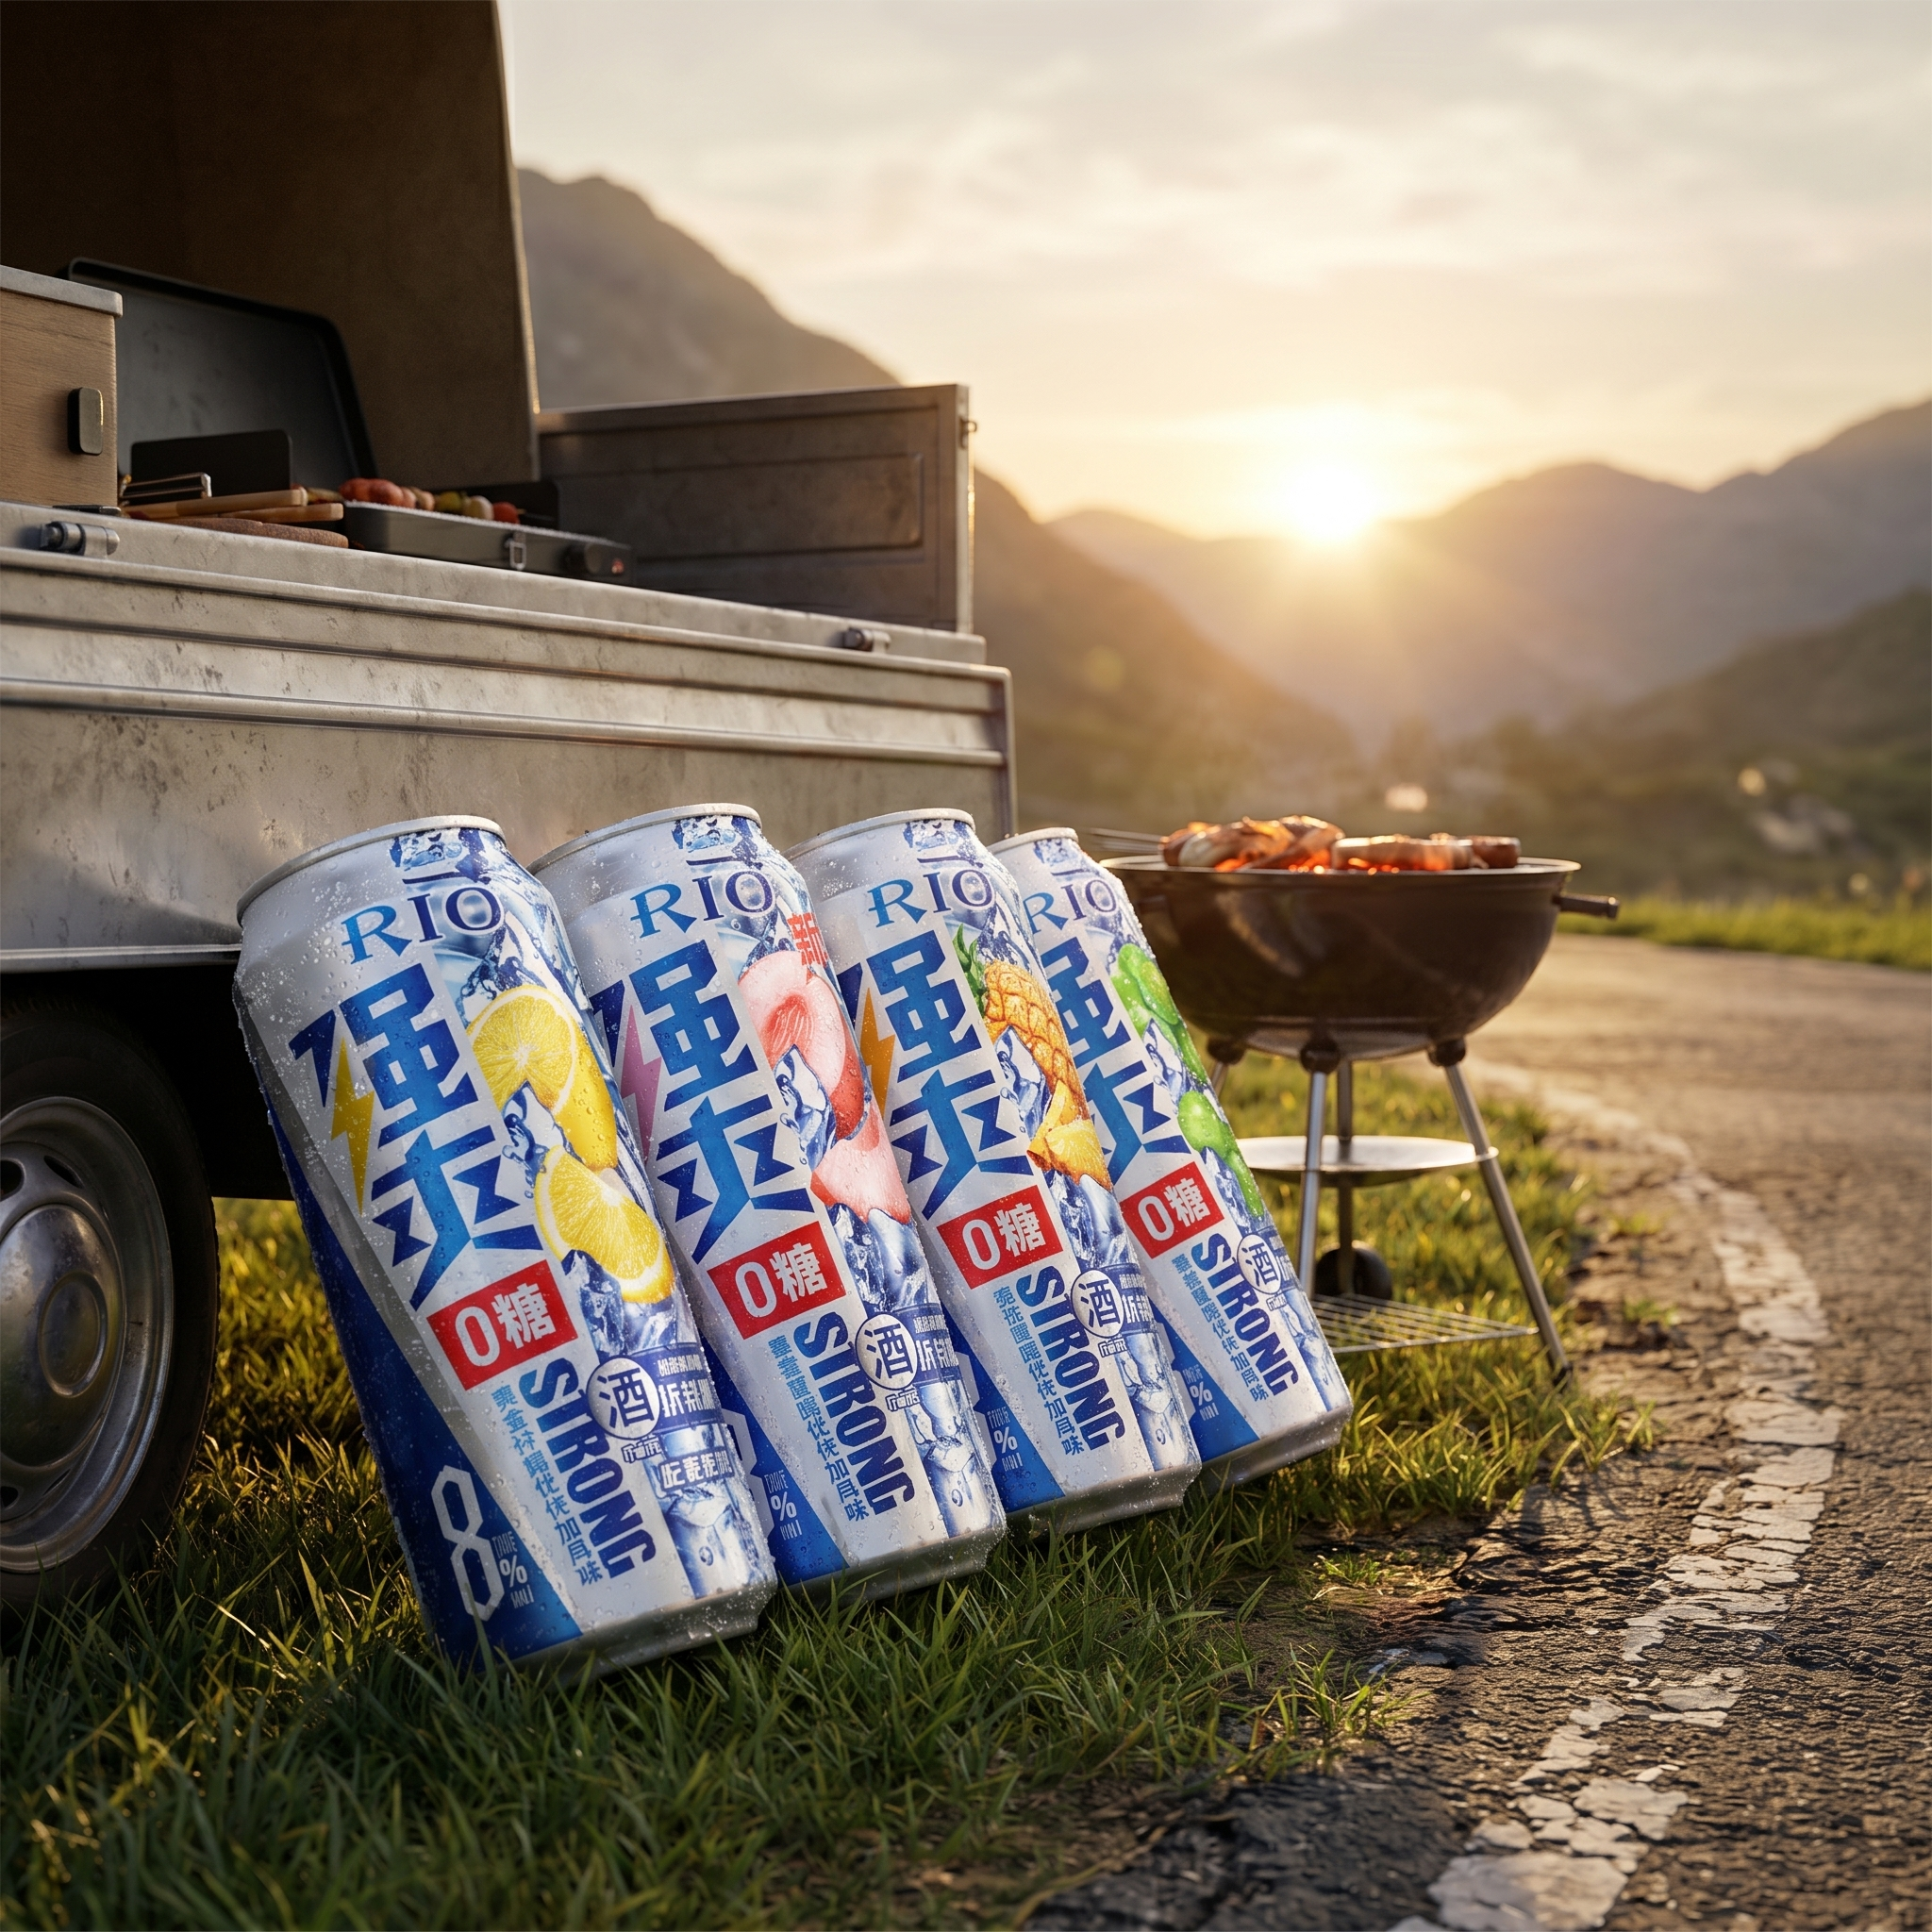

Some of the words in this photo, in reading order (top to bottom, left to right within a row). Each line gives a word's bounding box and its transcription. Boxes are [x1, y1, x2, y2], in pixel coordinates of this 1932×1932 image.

[341, 886, 502, 964] RIO
[630, 871, 774, 938] RIO
[867, 870, 994, 927] RIO
[1024, 879, 1118, 934] RIO
[288, 964, 543, 1310] 强爽
[962, 1203, 1046, 1270] 0糖
[1138, 1178, 1210, 1241] 0糖
[735, 1242, 827, 1318] 0糖
[1242, 1241, 1279, 1288] 酒
[455, 1283, 557, 1366] 0糖
[1079, 1278, 1122, 1328] 酒
[1191, 1233, 1298, 1396] STRONG
[864, 1323, 914, 1381] 酒
[1016, 1266, 1125, 1450] STRONG
[597, 1367, 655, 1429] 酒
[793, 1311, 915, 1515] STRONG
[519, 1357, 657, 1579] STRONG
